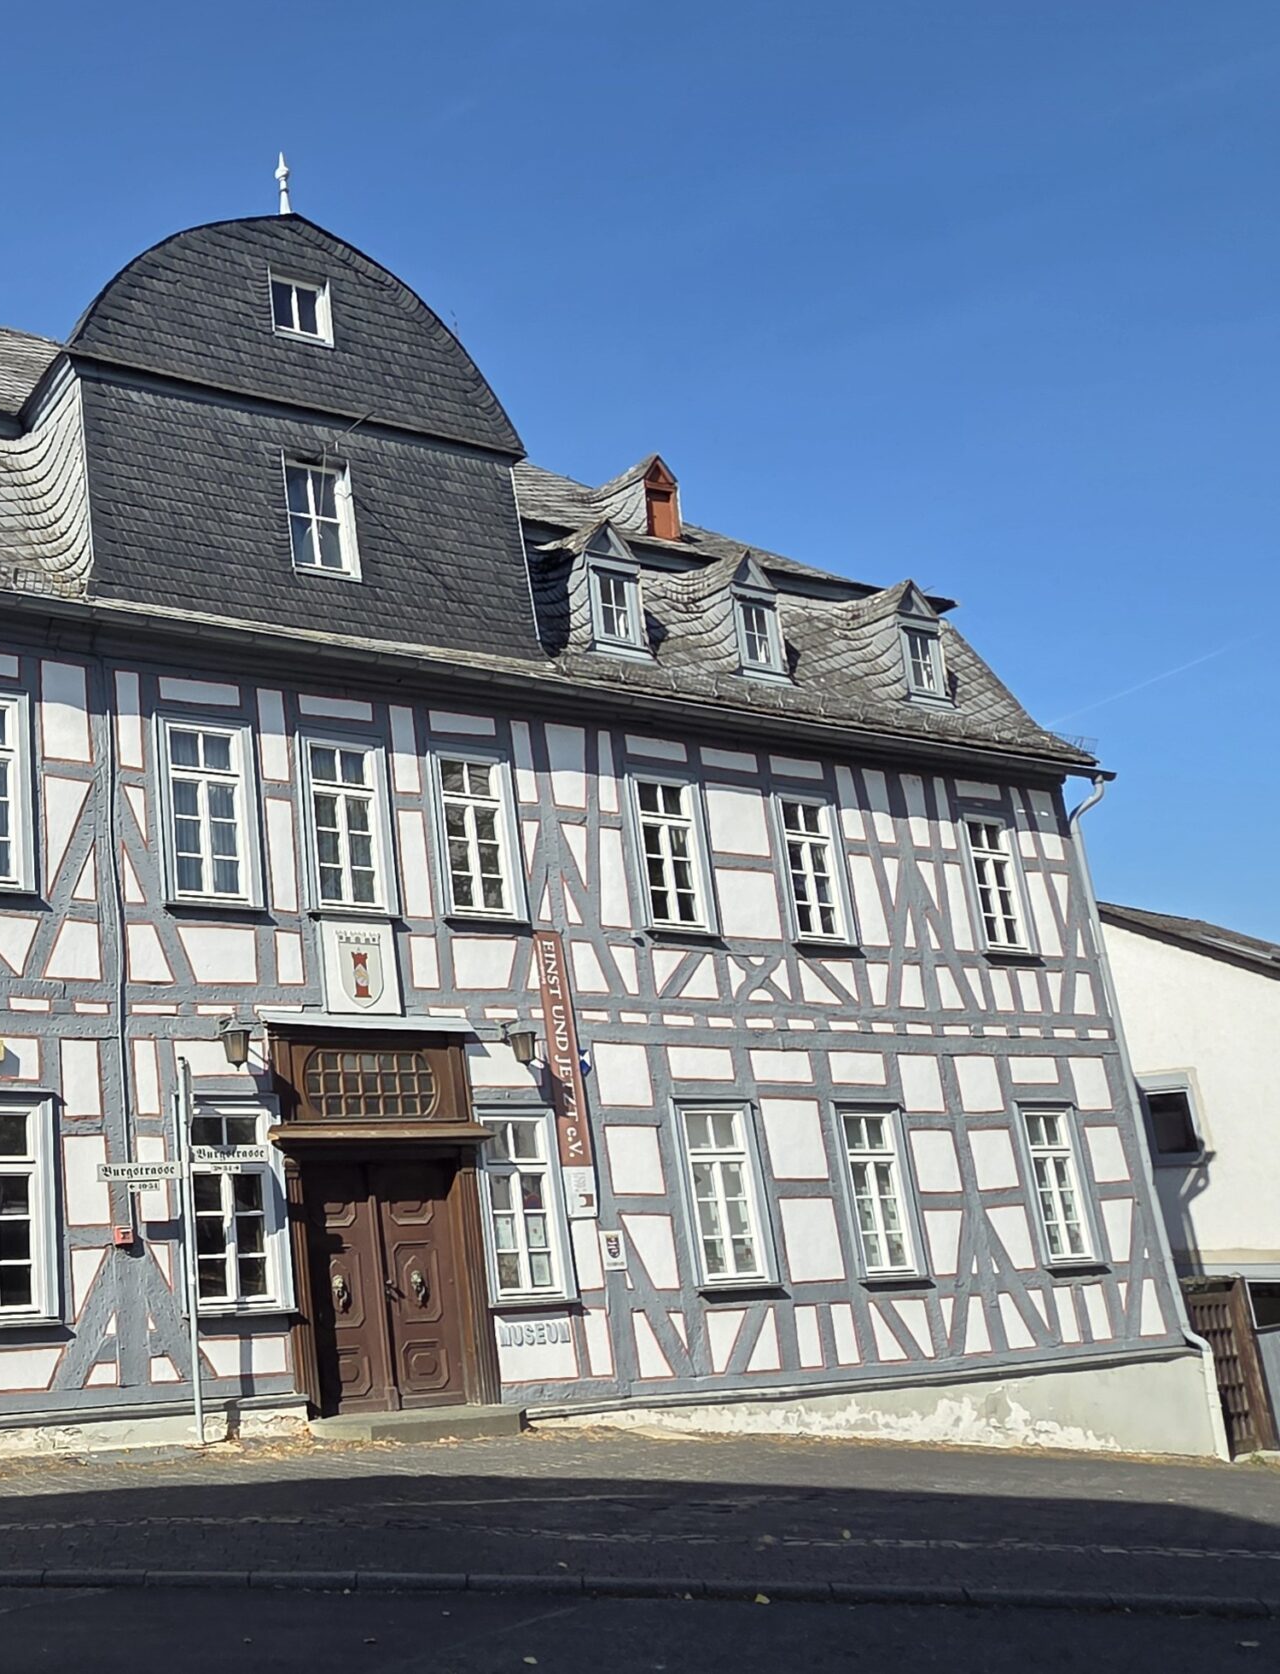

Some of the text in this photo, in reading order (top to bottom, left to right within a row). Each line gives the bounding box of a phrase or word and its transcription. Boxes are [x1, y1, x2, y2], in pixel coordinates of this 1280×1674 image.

[542, 940, 563, 1000] EINST
[551, 1004, 570, 1052] UND
[554, 1054, 580, 1122] JETZT
[101, 1165, 176, 1179] Burgstrasse
[499, 1321, 572, 1347] MUSEUM
